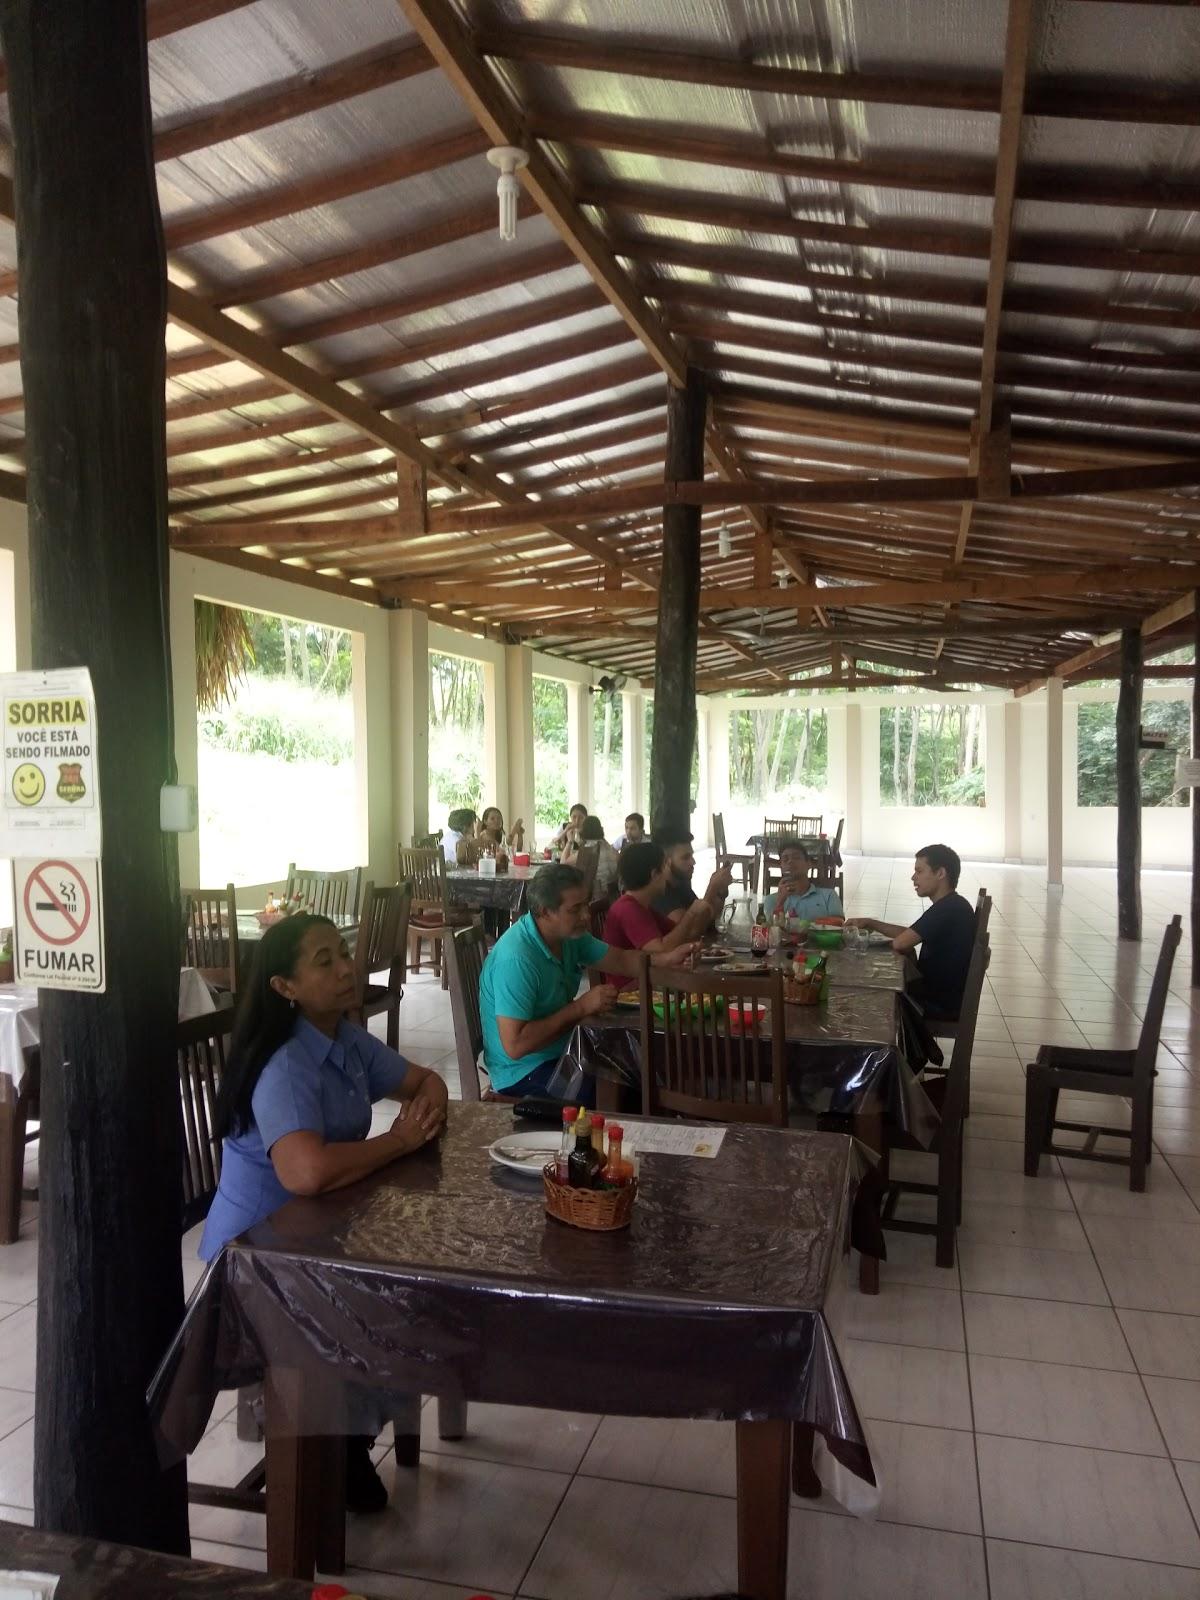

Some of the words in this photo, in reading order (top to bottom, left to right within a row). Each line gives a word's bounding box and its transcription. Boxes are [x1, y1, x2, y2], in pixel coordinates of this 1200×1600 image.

[9, 700, 86, 725] SORRIA
[17, 728, 47, 743] VOCÊ
[50, 726, 79, 742] ESTÁ
[5, 747, 41, 759] SENDO
[44, 745, 90, 758] FILMADO
[24, 949, 95, 973] FUMAR
